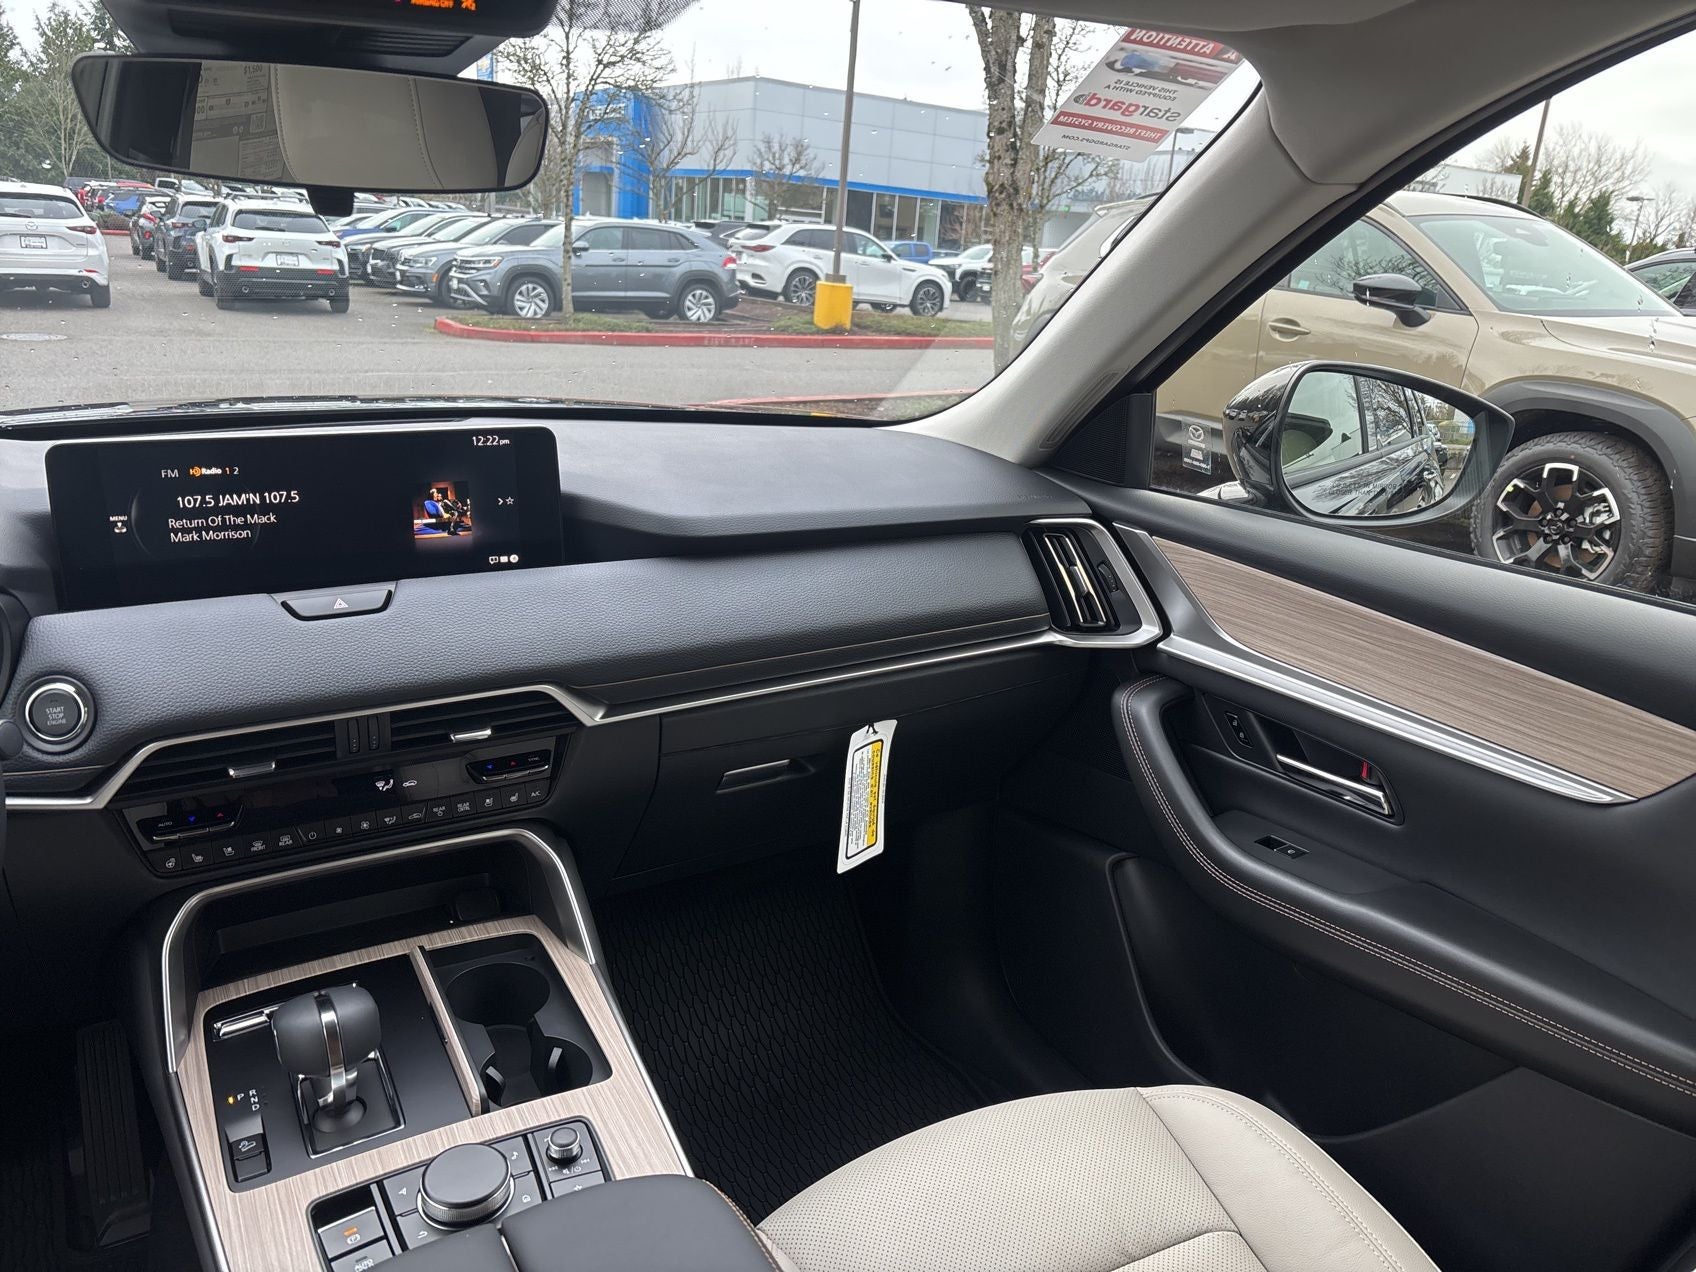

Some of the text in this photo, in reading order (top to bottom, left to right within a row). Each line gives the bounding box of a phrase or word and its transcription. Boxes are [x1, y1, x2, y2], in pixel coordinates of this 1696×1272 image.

[161, 469, 179, 479] FM
[233, 467, 239, 475] 2
[176, 490, 300, 508] 107.5 JAM'N 107.5
[168, 512, 277, 529] Return Of The Mack
[170, 528, 252, 543] Mark Morrison
[46, 706, 64, 714] START
[47, 718, 66, 726] ENGINE
[237, 1093, 244, 1101] P
